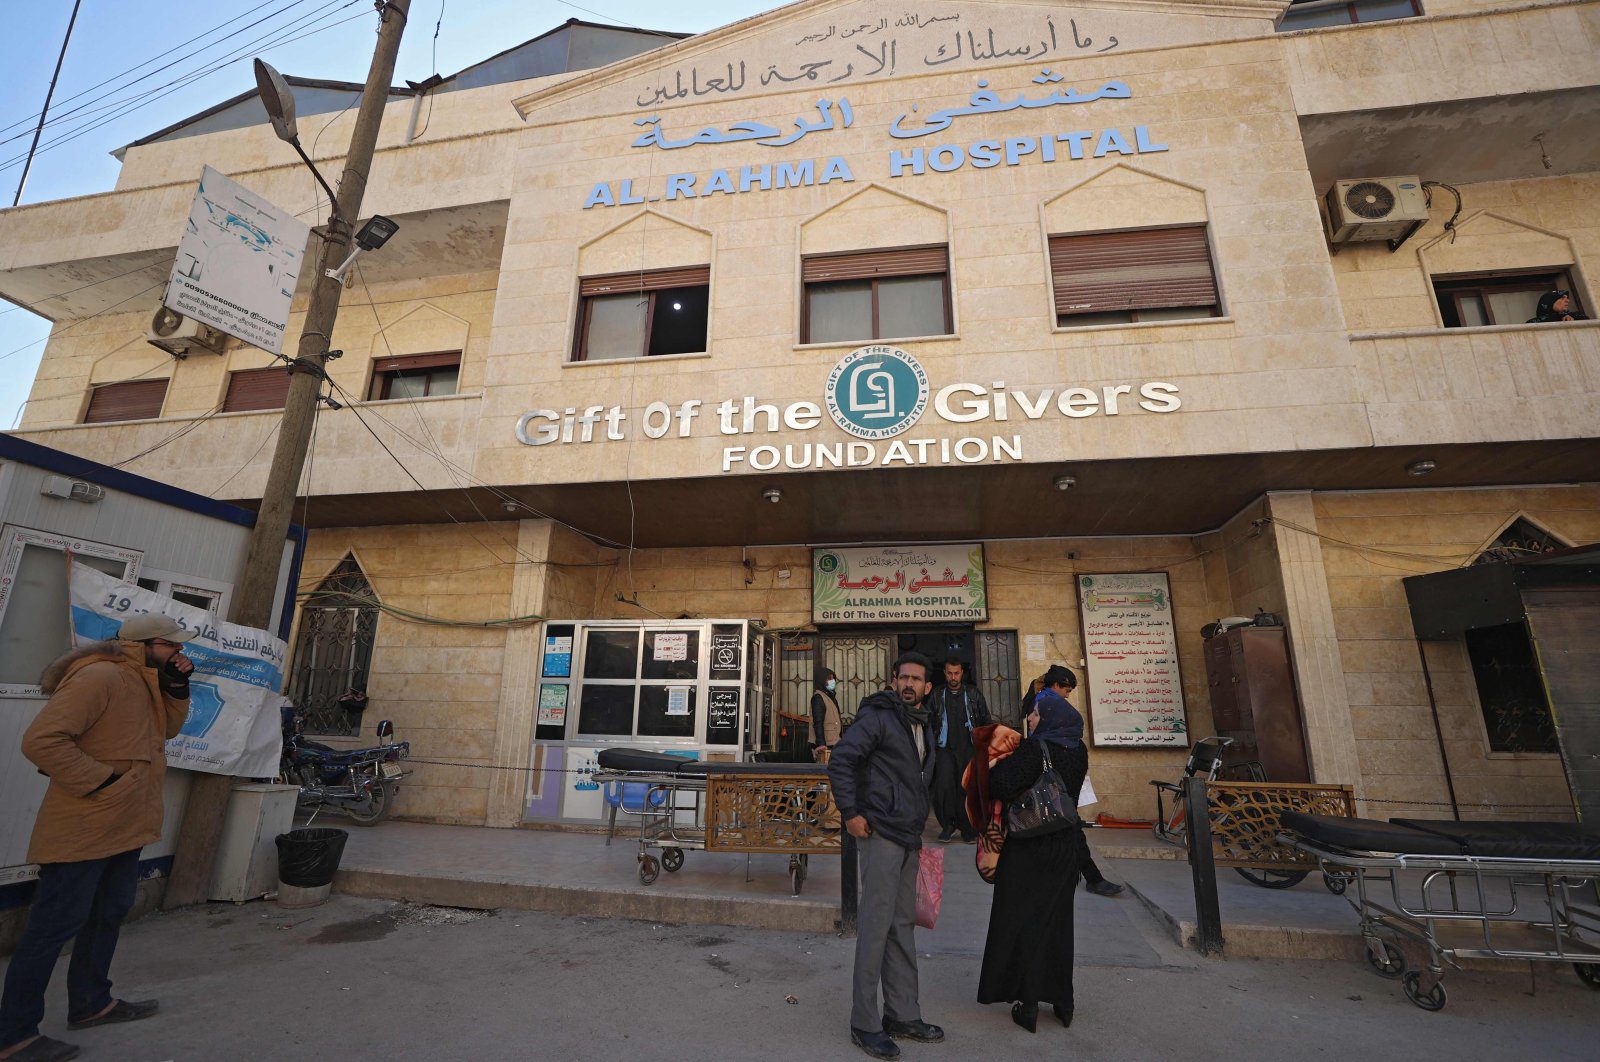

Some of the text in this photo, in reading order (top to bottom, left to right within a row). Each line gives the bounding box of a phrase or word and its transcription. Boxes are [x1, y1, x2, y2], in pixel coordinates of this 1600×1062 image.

[795, 25, 836, 46] الرحيم
[840, 18, 888, 39] الرحمن
[636, 63, 746, 108] للعالمين
[760, 58, 853, 84] رحمة
[631, 68, 1132, 150] مشفى الرحمة
[889, 124, 1170, 178] HOSPITAL
[827, 365, 842, 391] GIFT
[844, 351, 860, 363] OF
[863, 346, 891, 354] THE
[514, 405, 625, 446] Gift
[716, 396, 823, 435] the
[934, 380, 1182, 423] Givers
[828, 403, 878, 438] AL-RAHMA
[722, 434, 1023, 472] FOUNDATION
[837, 567, 970, 594] مشفى الرحمة
[103, 594, 131, 613] 19
[822, 608, 982, 619] Gift Of The Givers FOUNDATION
[844, 596, 965, 608] ALRAHMA HOSPITAL
